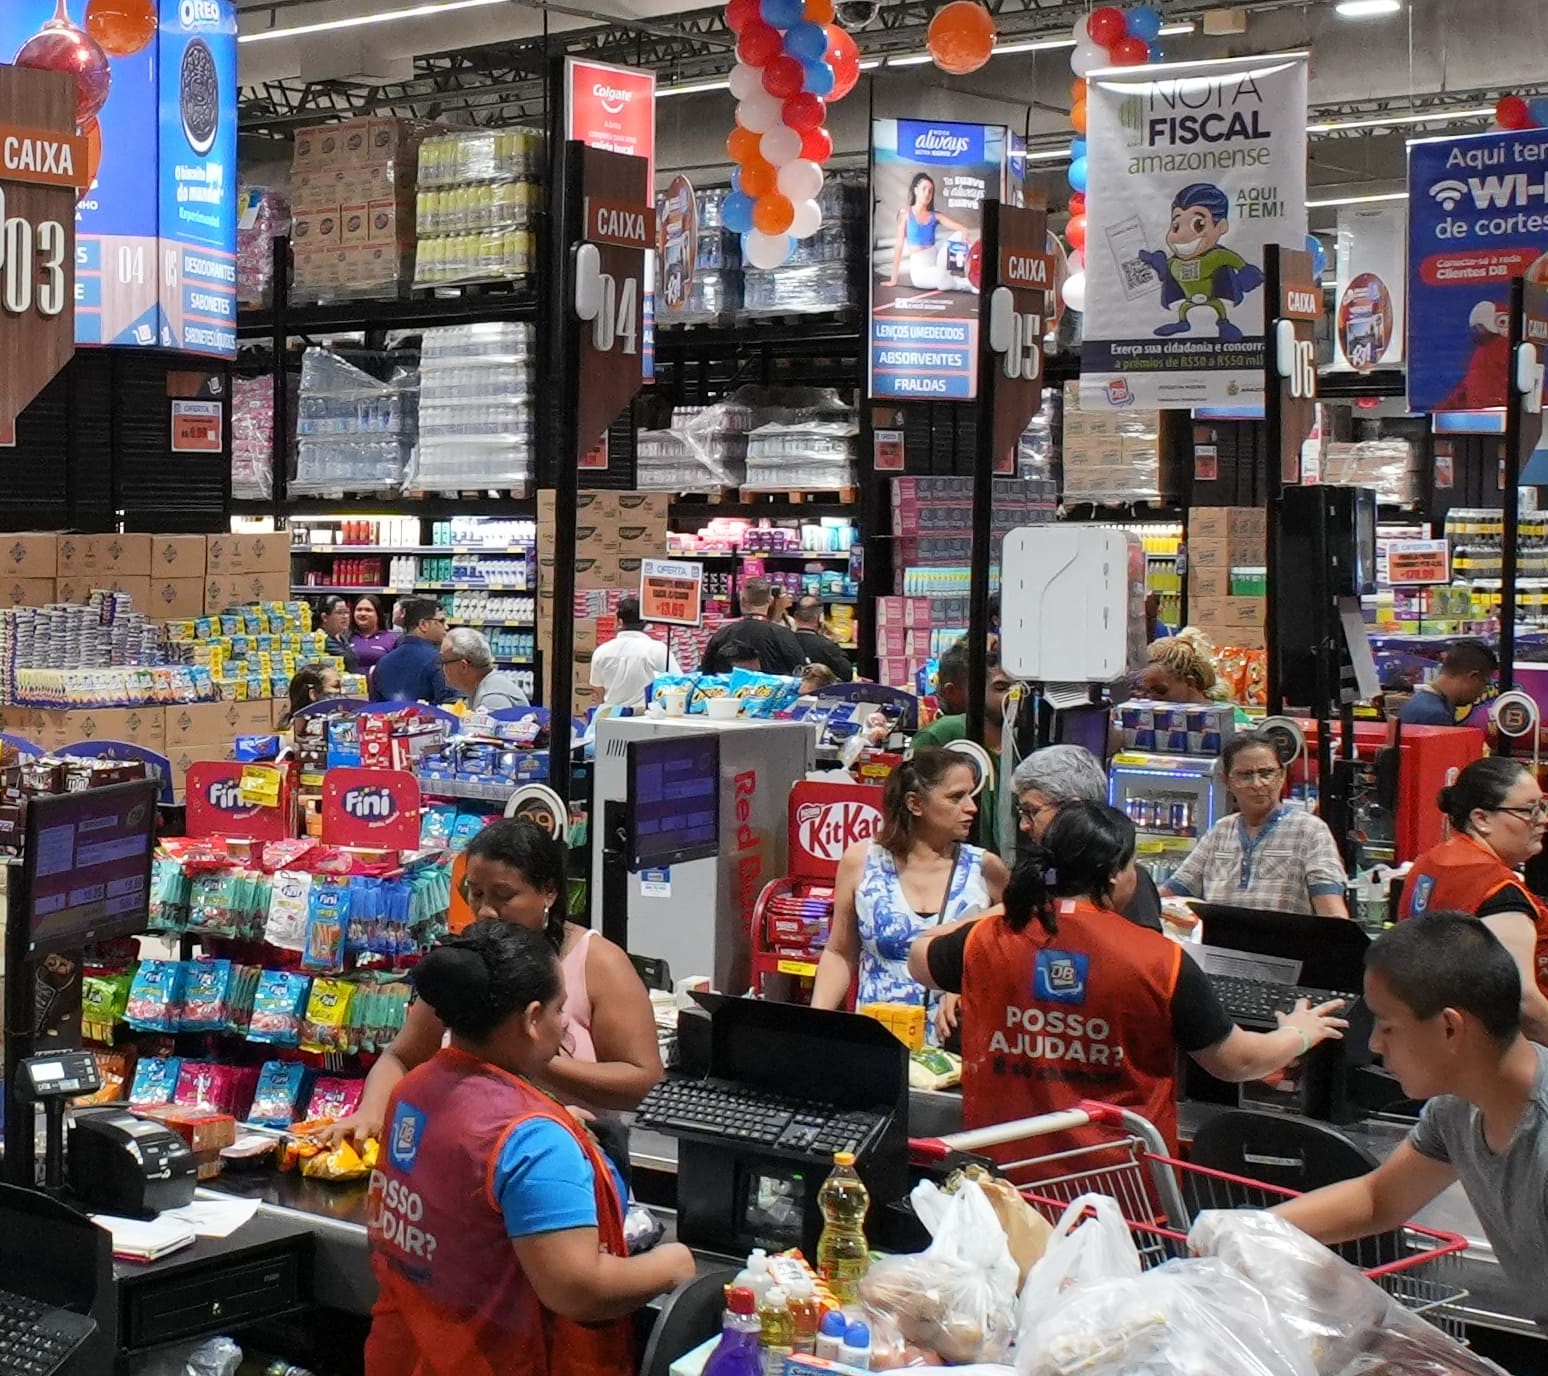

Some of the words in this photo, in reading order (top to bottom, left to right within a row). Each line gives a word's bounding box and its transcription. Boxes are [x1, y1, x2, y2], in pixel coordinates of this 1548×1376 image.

[592, 83, 633, 103] Colgate
[1149, 110, 1272, 147] FISCAL
[915, 129, 969, 157] always
[1446, 142, 1505, 170] Aqui
[4, 135, 74, 178] CAIXA
[1128, 146, 1271, 175] amazonense
[1236, 187, 1277, 202] AQUI
[1236, 201, 1285, 219] TEM!
[598, 207, 646, 241] CAIXA
[1435, 217, 1468, 239] de
[3, 216, 67, 318] 03
[118, 245, 145, 285] 04
[184, 256, 236, 282] DESODORANTES
[1008, 255, 1047, 283] CAIXA
[190, 292, 231, 315] SABONETES
[1288, 290, 1316, 314] CAIXA
[875, 324, 910, 341] LENÇOS
[911, 325, 965, 342] UMEDECIDOS
[1528, 318, 1548, 338] CAIXA
[879, 352, 962, 367] ABSORVENTES
[1144, 344, 1161, 354] sua
[1163, 341, 1213, 354] cidadania
[1166, 355, 1178, 368] de
[894, 378, 946, 394] FRALDAS
[209, 780, 253, 810] Fin
[344, 787, 391, 817] Fini
[1050, 964, 1076, 982] DB
[1006, 1005, 1110, 1041] POSSO
[988, 1029, 1125, 1067] AJUDAR?
